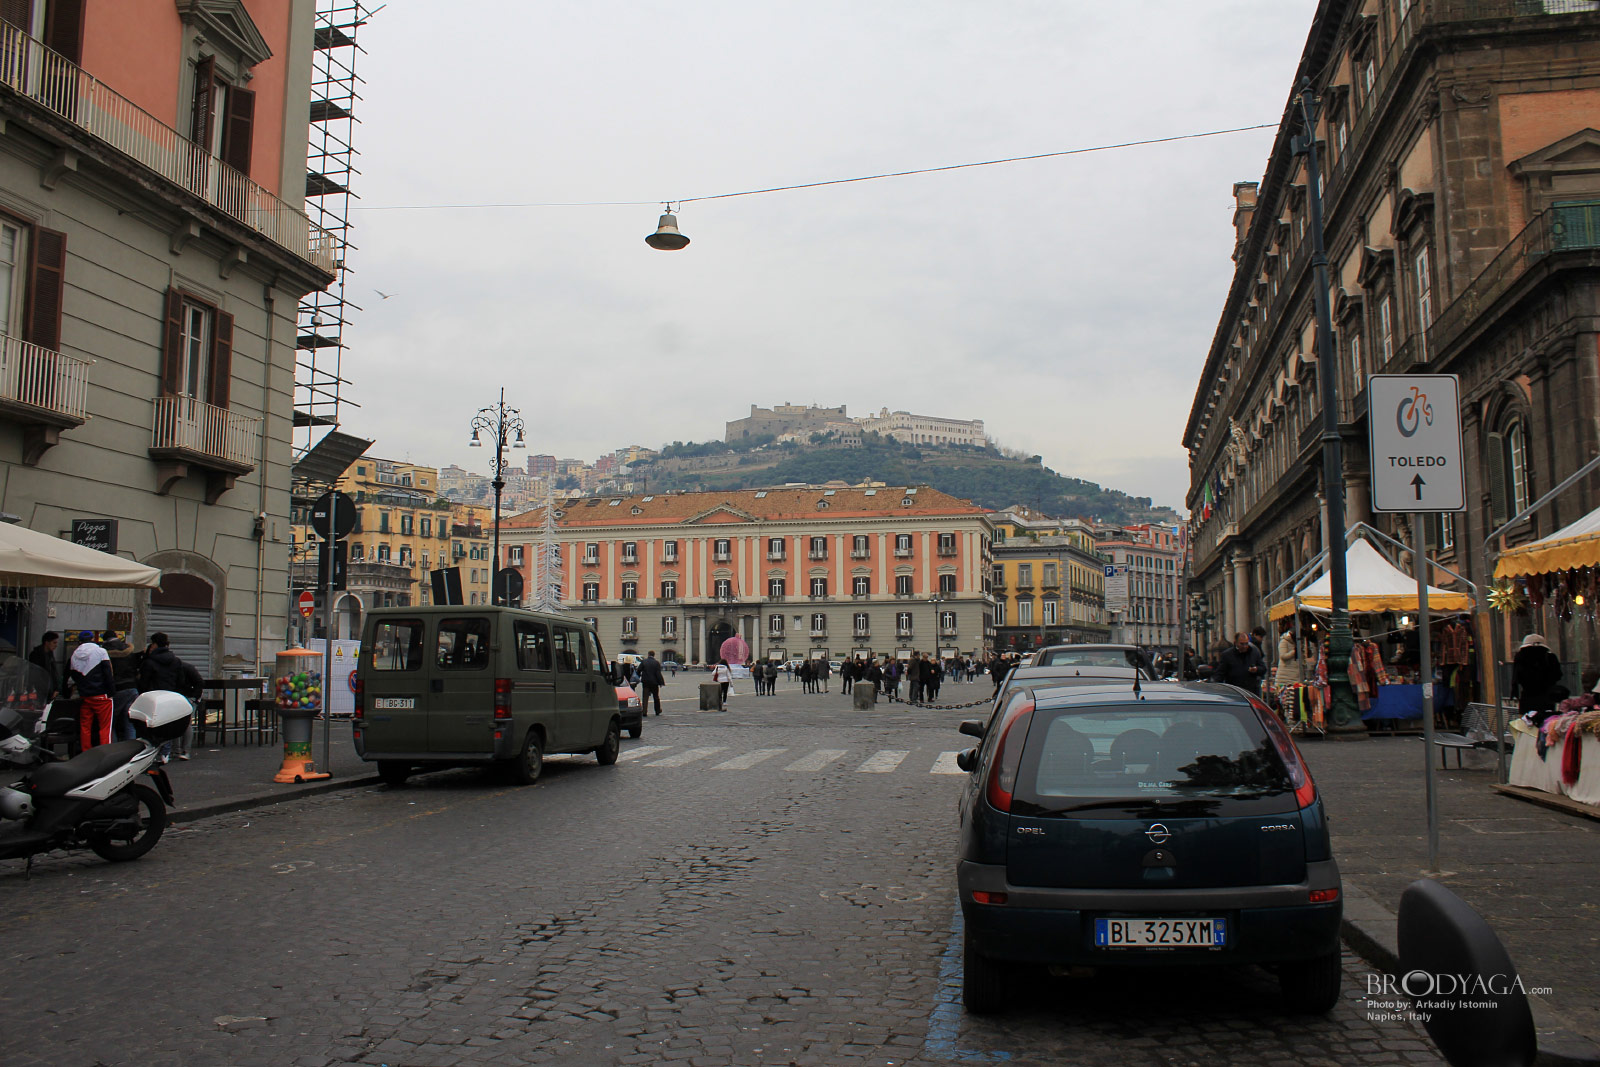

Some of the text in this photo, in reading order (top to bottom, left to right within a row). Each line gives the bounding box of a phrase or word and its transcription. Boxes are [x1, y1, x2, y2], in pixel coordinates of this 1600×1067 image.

[1388, 457, 1447, 467] TOLEDO
[77, 521, 106, 534] Pizza
[85, 533, 97, 541] in
[1106, 567, 1112, 576] P
[1016, 827, 1046, 835] OPEL
[1260, 824, 1296, 832] CORSA
[1214, 932, 1225, 943] LT
